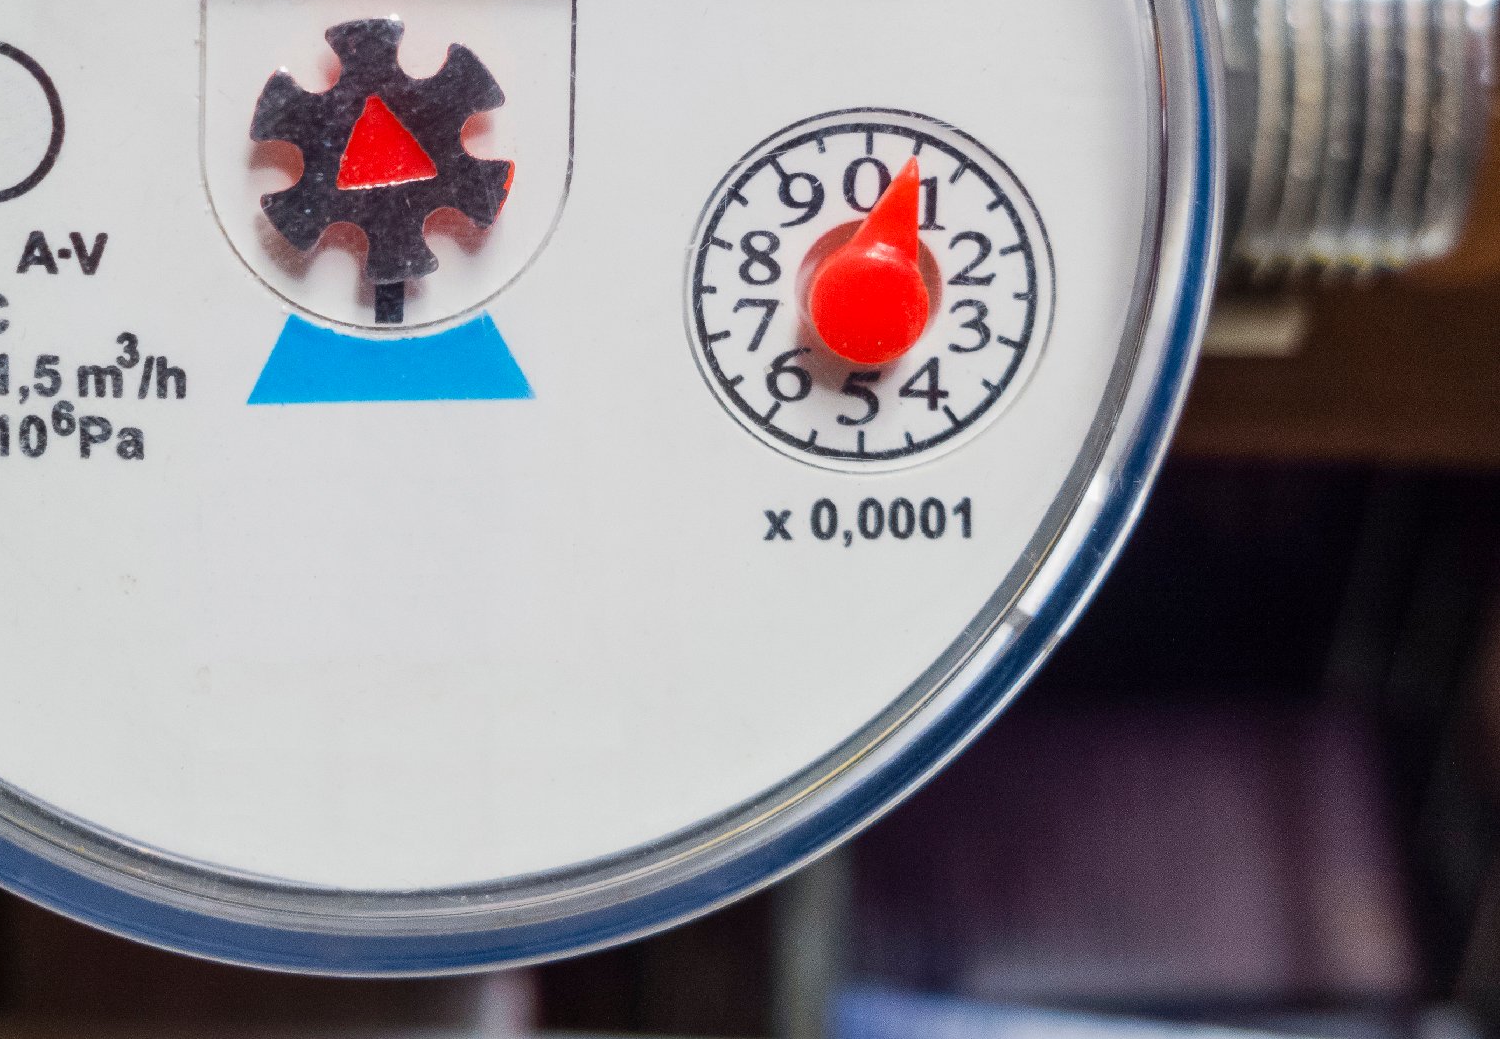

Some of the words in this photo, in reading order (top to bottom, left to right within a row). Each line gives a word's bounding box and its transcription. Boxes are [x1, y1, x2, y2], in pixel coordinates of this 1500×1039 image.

[777, 171, 825, 228] 9
[16, 229, 109, 276] A-V
[738, 230, 782, 285] 8
[947, 231, 997, 286] 2
[733, 298, 780, 352] 7
[948, 299, 991, 353] 3
[765, 348, 812, 403] 6
[836, 371, 881, 427] 5
[899, 357, 949, 411] 4
[763, 509, 794, 541] x
[810, 496, 972, 547] 0,0001
